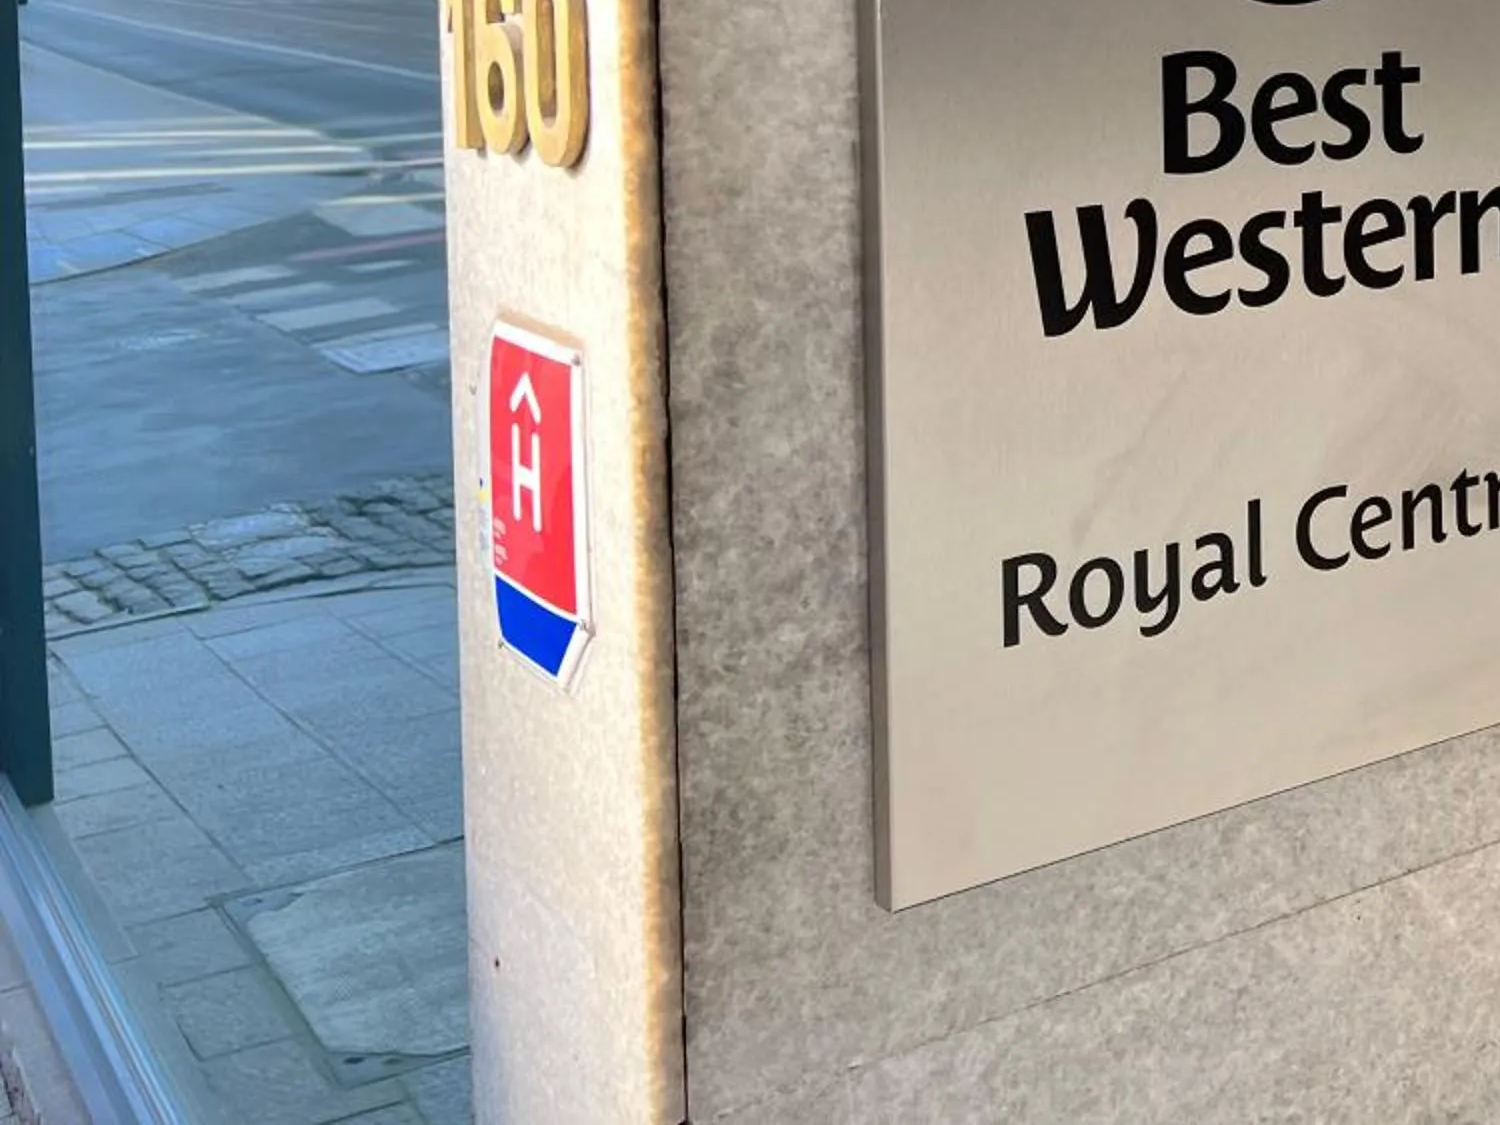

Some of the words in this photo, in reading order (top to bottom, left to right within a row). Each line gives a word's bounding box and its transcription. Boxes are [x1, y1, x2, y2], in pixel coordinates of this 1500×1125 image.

[1161, 49, 1425, 175] Best
[511, 422, 543, 533] H
[1001, 497, 1268, 648] Royal
